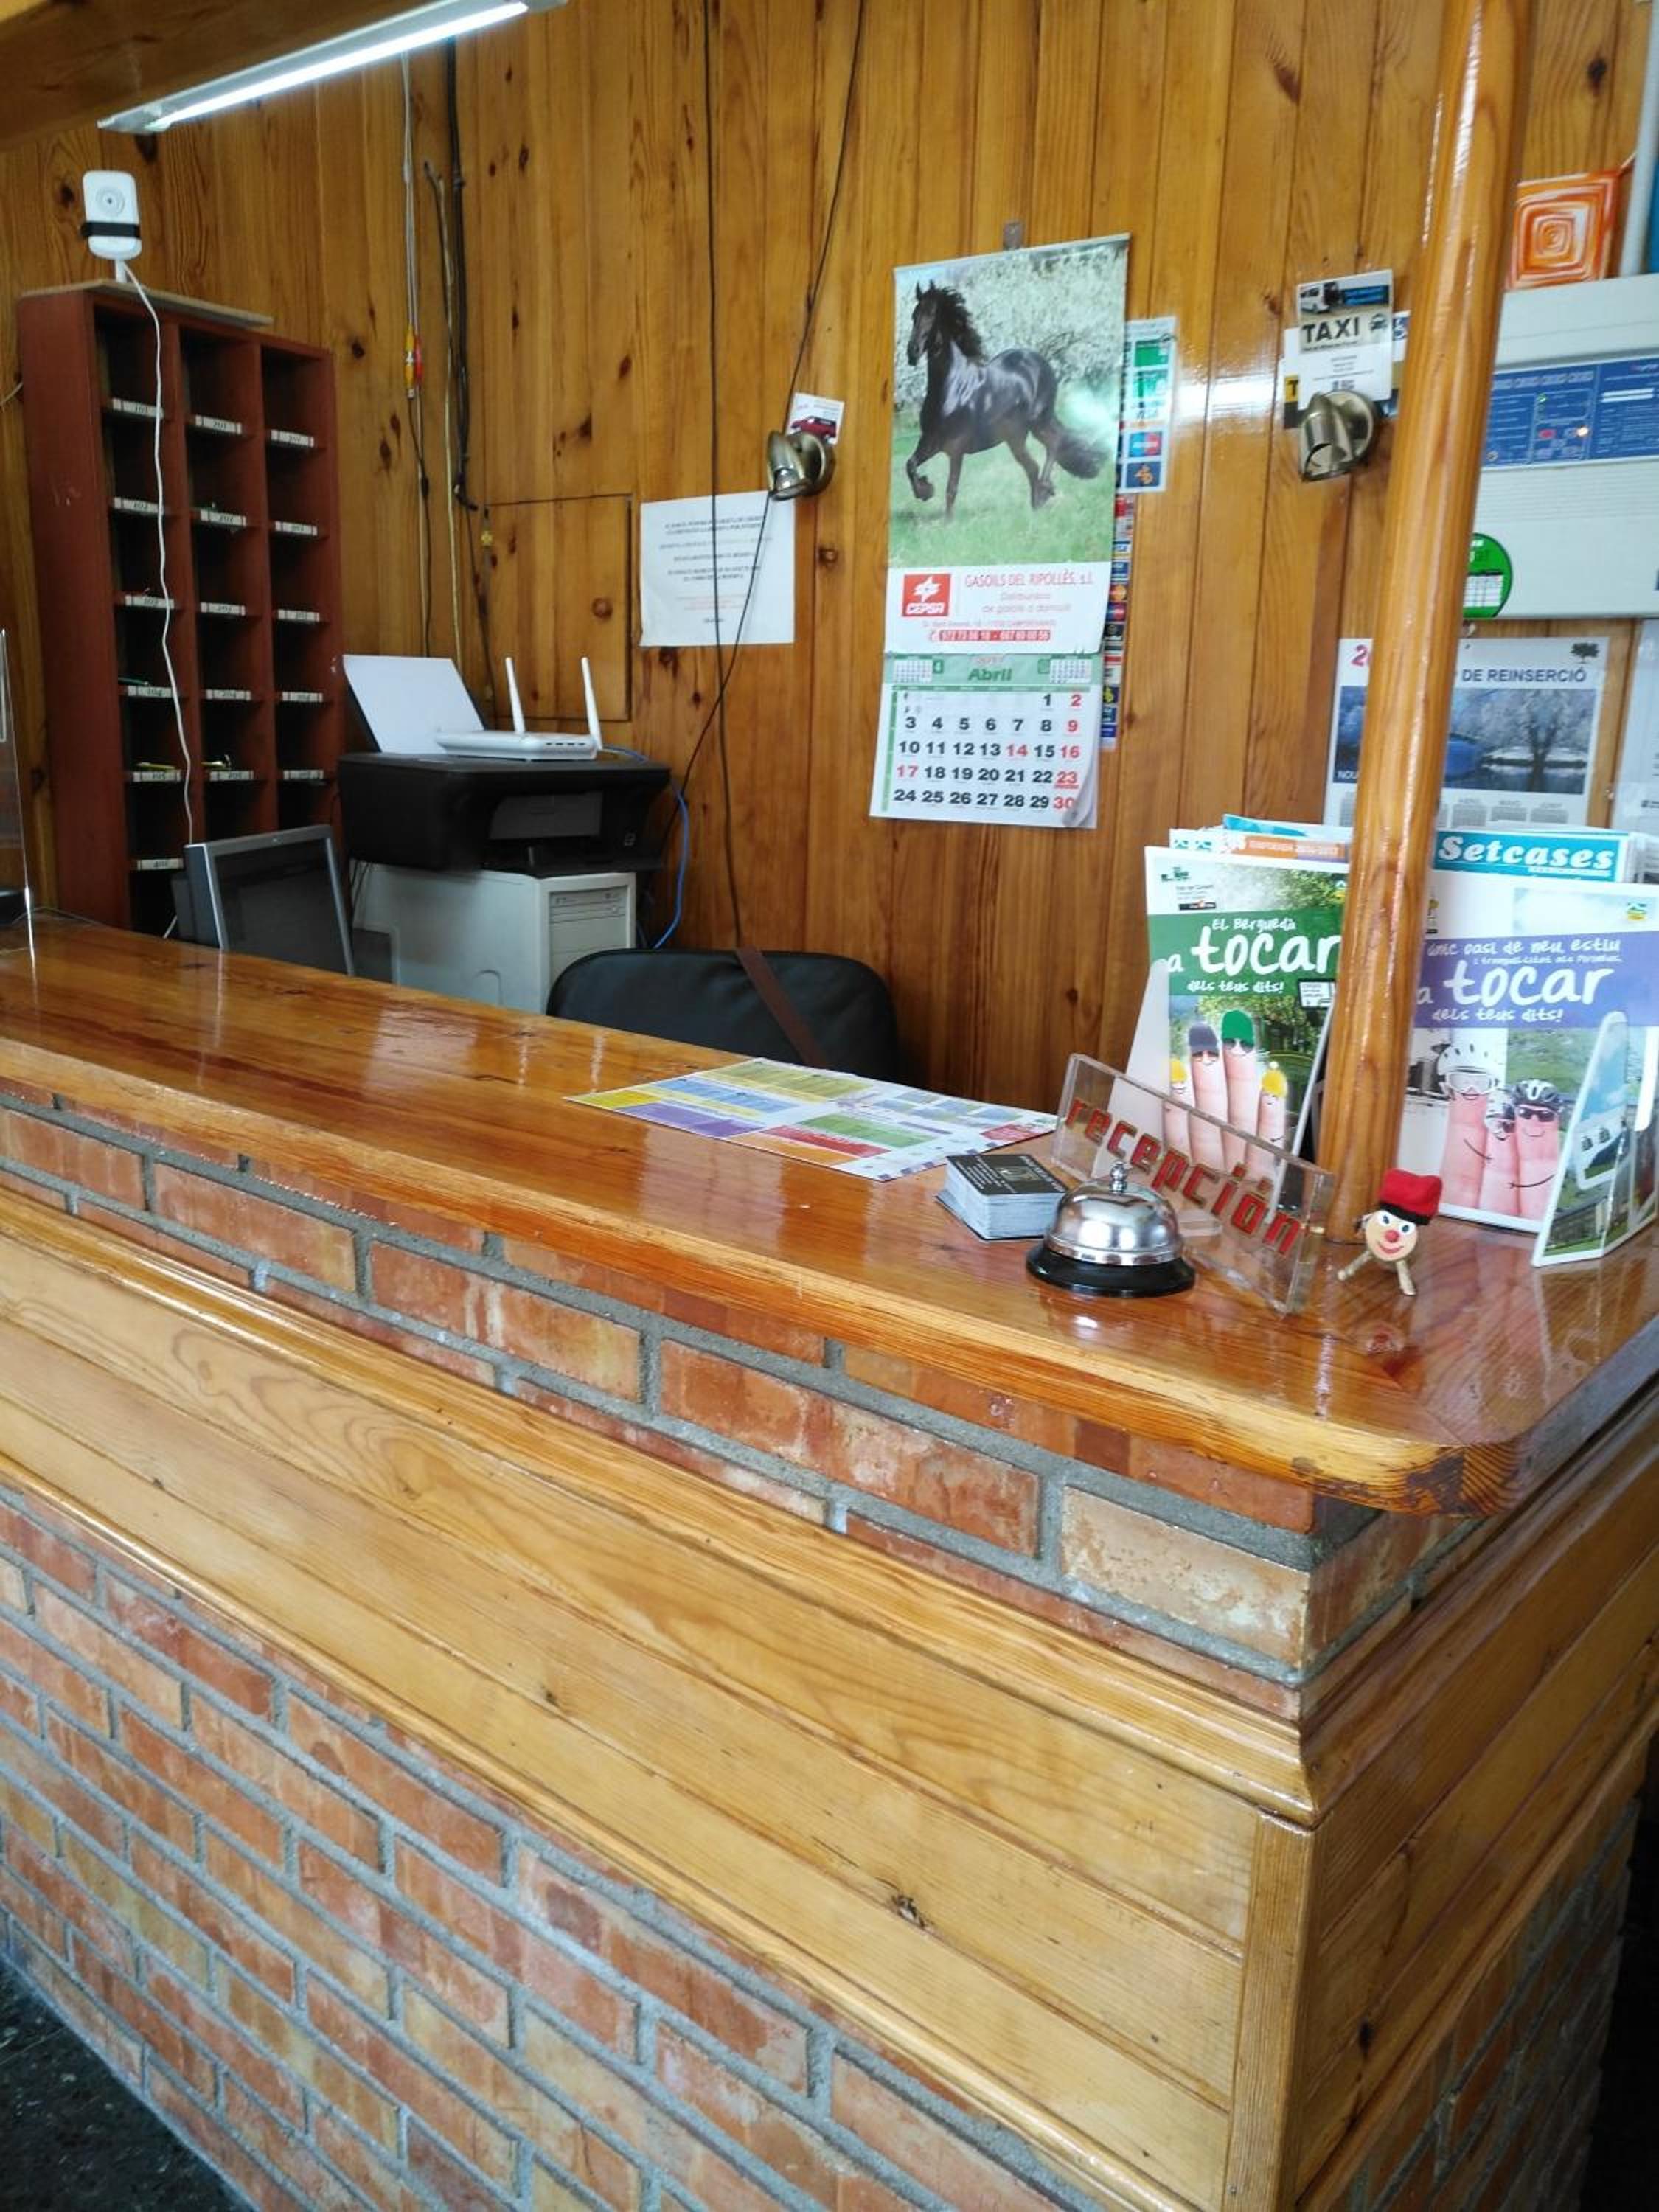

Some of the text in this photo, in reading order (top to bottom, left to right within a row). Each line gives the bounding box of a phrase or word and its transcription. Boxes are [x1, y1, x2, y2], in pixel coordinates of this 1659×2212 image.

[1302, 316, 1360, 343] TAXI
[969, 669, 1012, 682] Abril
[1462, 665, 1587, 684] DE REINSERCIÓ
[1043, 694, 1081, 706] 1 2
[905, 717, 1078, 732] 3 4 5 6 7 8 9
[899, 741, 1080, 758] 10 11 12 13 14 15 16
[897, 765, 1077, 784] 17 18 19 20 21 22 23
[894, 789, 1075, 810] 24 25 26 27 28 29 30
[1439, 835, 1614, 869] Setcases
[1167, 925, 1342, 977] a tocar
[1503, 940, 1525, 954] de
[1531, 940, 1565, 954] neu
[1571, 937, 1621, 952] estiu
[1218, 981, 1249, 992] teus
[1416, 960, 1614, 1008] a tocar
[1432, 1008, 1563, 1023] dels teus dits!
[1065, 1098, 1303, 1256] recepción
